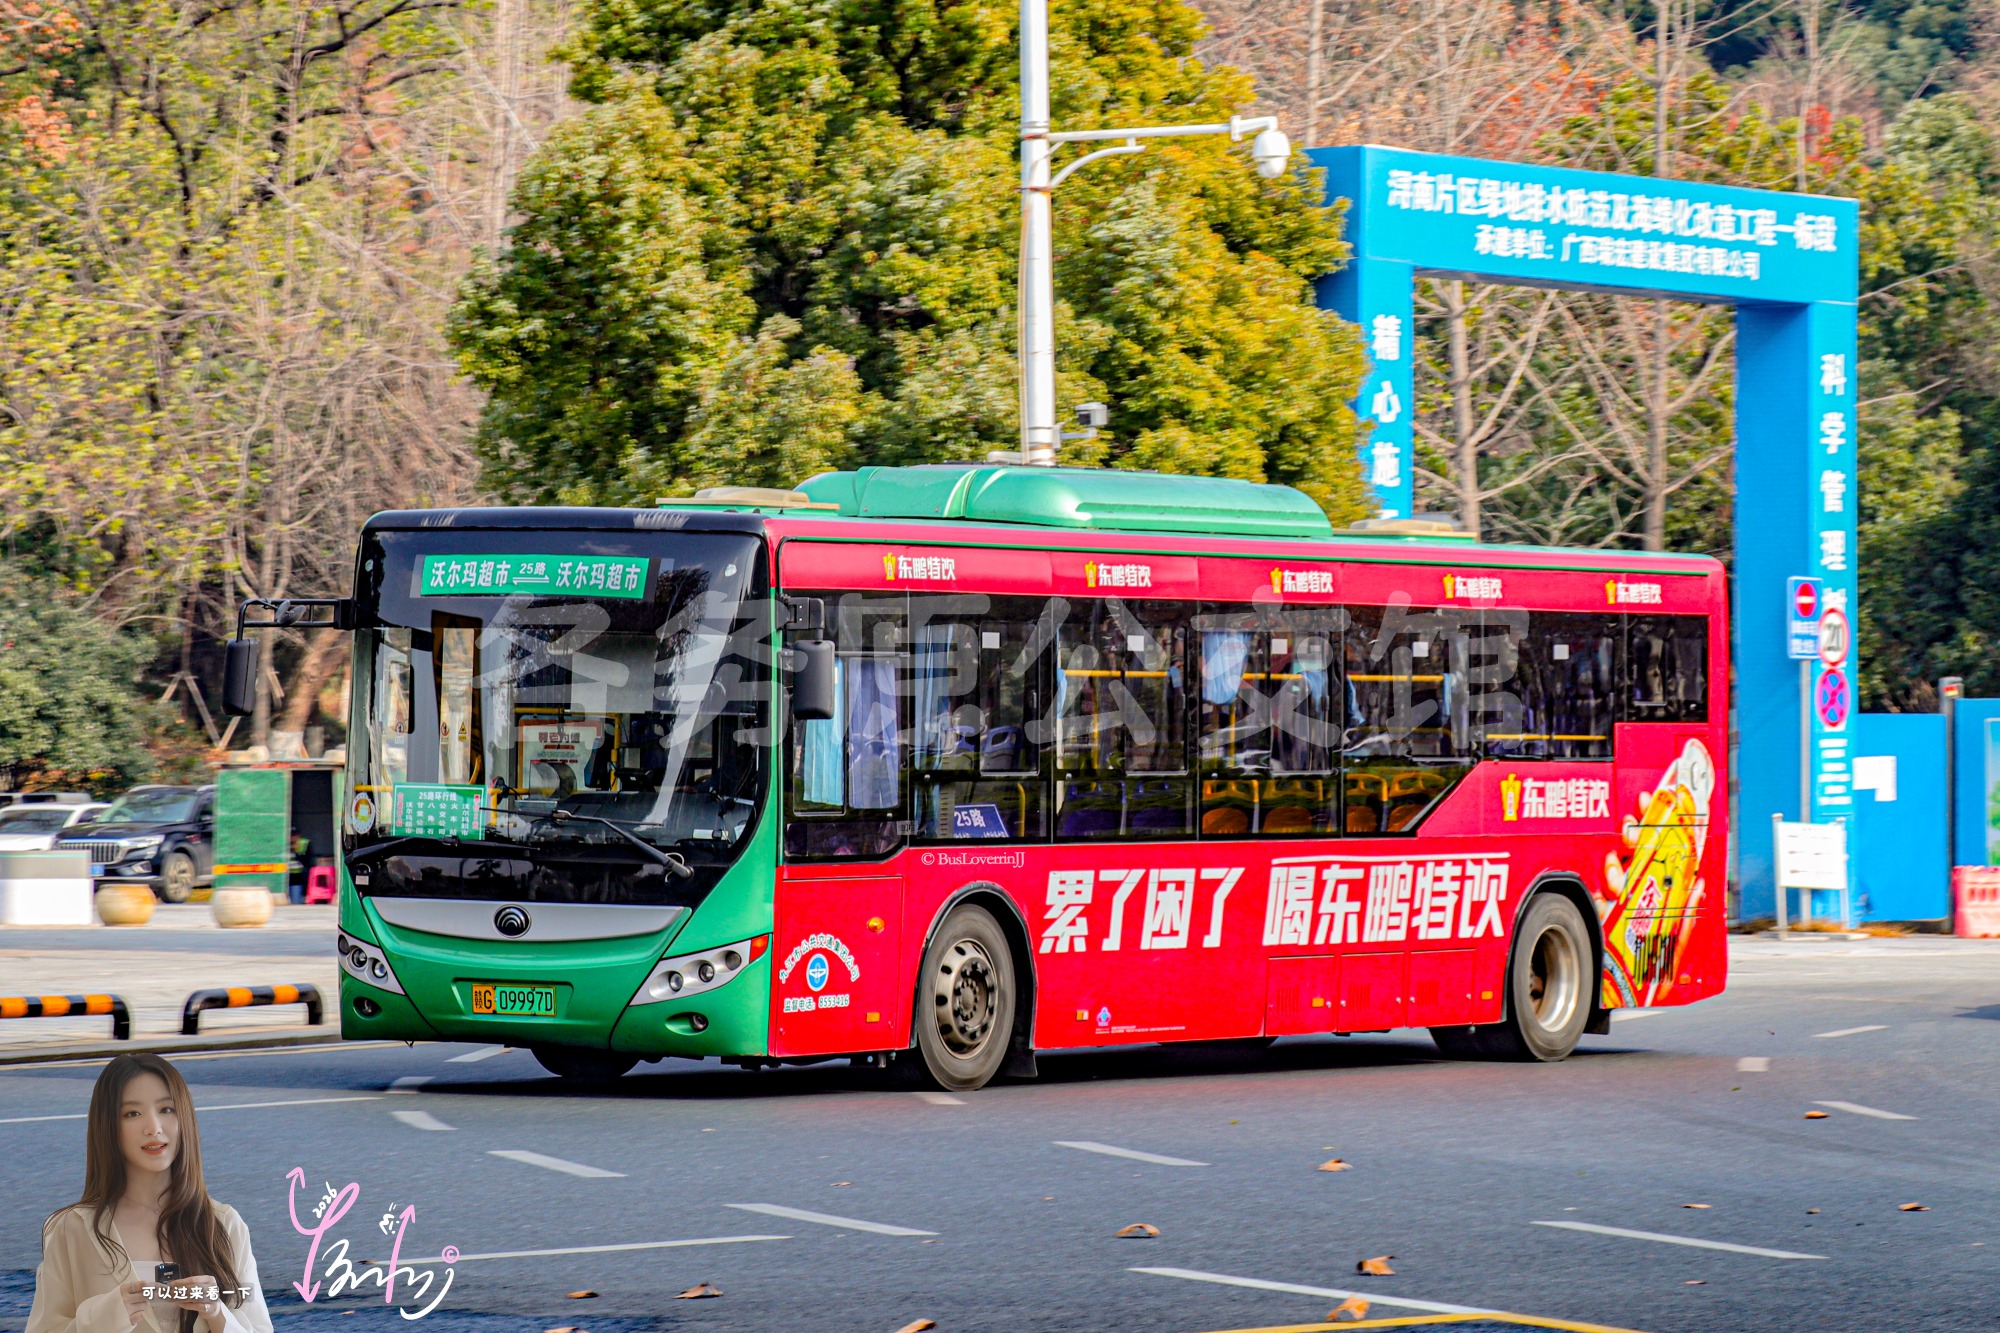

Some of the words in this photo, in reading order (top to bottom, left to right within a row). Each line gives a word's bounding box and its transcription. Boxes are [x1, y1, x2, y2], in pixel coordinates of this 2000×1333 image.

[1372, 314, 1401, 519] 精心施
[429, 560, 511, 588] 沃尔玛超市
[519, 562, 547, 576] 25路
[556, 561, 641, 590] 沃尔玛超市
[898, 556, 956, 581] 东鹏特饮
[1099, 563, 1152, 587] 东鹏特饮
[1283, 570, 1334, 594] 东鹏特饮
[1455, 576, 1503, 599] 东鹏特饮
[1617, 582, 1662, 604] 东鹏特饮
[1522, 778, 1610, 819] 东鹏特饮
[954, 808, 986, 827] 25路
[1039, 867, 1245, 954] 累了困了
[1262, 858, 1510, 946] 喝东鹏特饮
